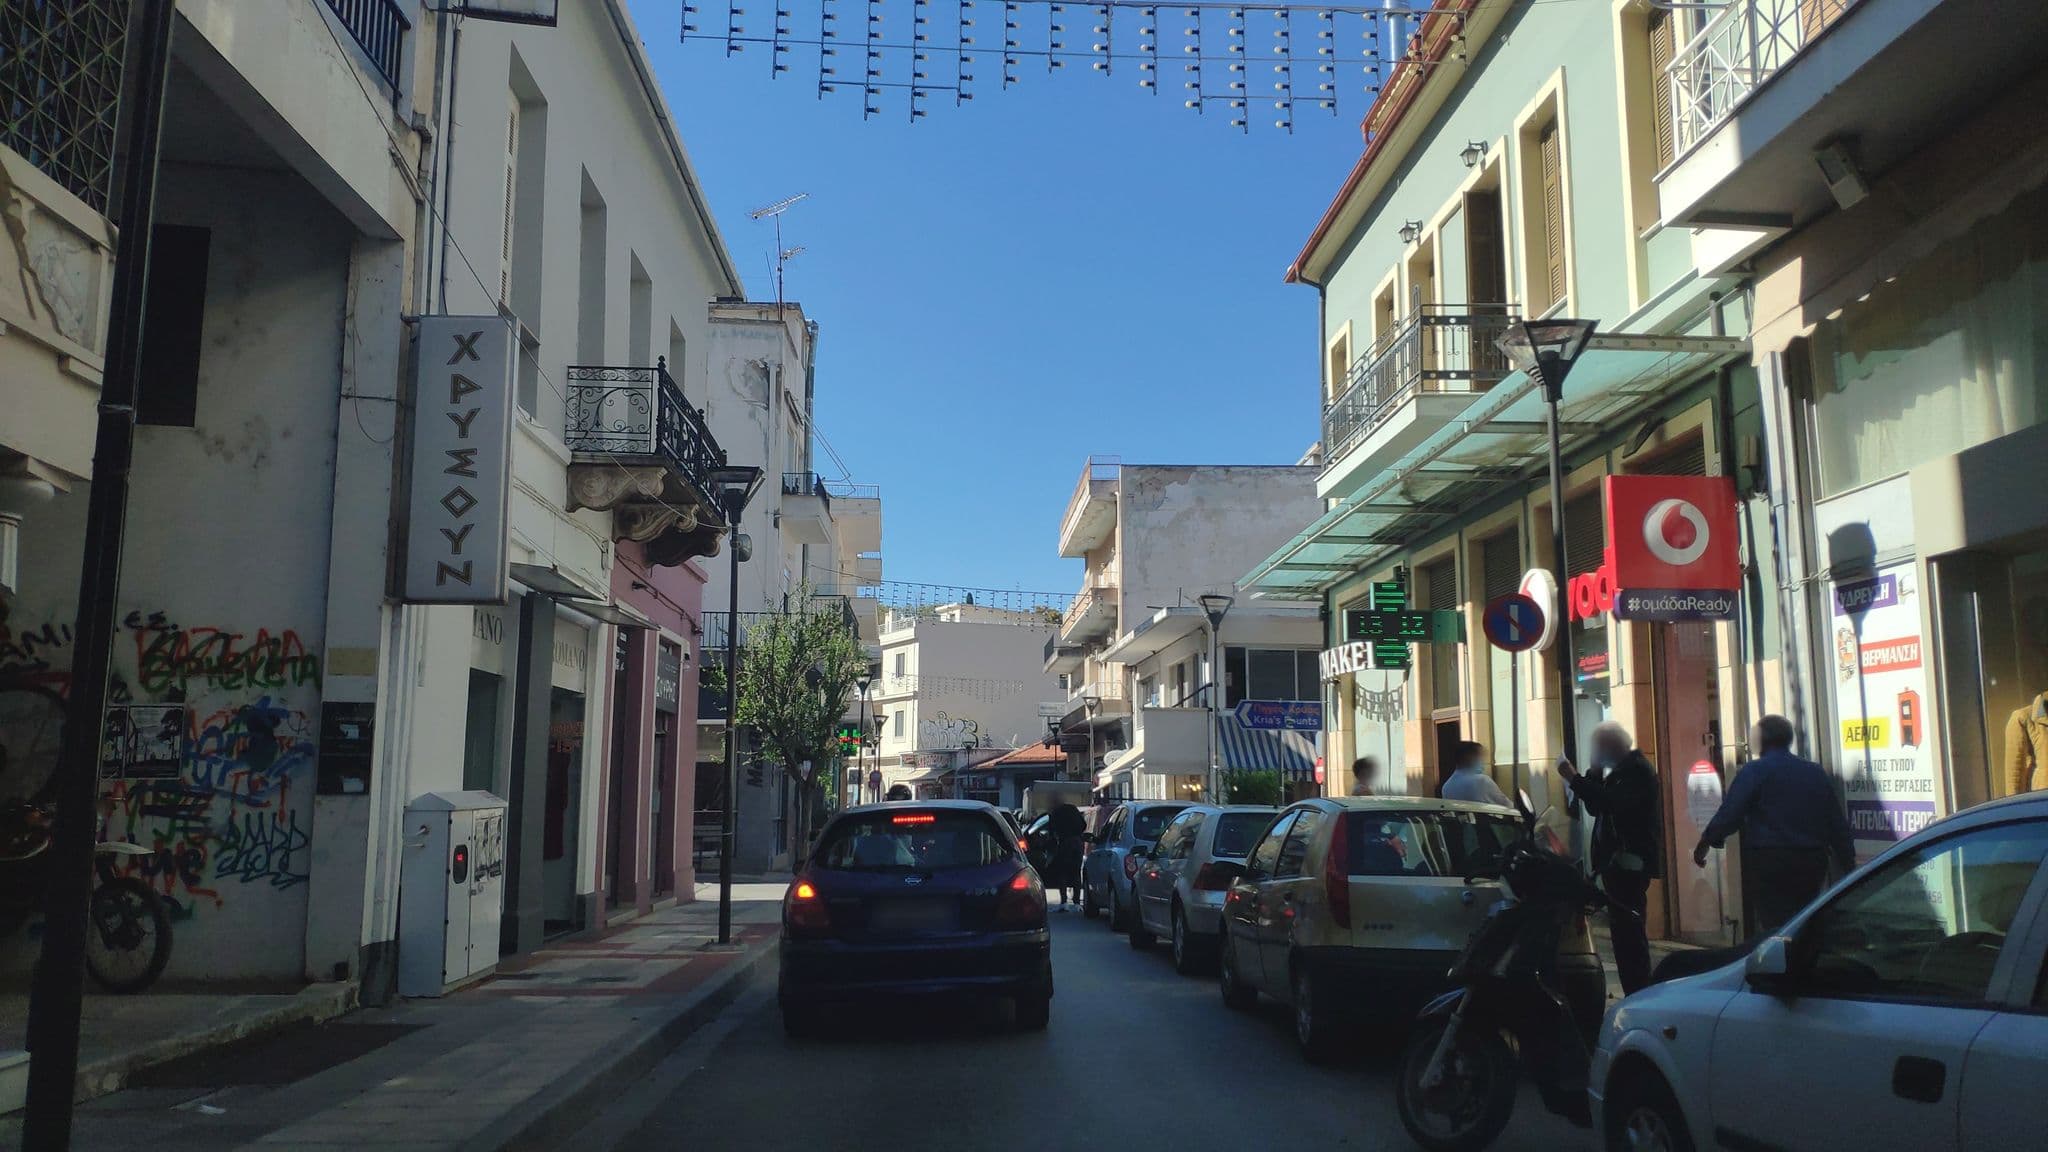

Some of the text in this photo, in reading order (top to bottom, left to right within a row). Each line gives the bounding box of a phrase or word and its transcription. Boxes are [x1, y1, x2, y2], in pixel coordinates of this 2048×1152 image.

[1628, 596, 1732, 614] #ομάδαReady
[1862, 643, 1918, 667] ΘΕΡΜΑΝΣΗ
[1254, 715, 1281, 725] Kria's
[1845, 725, 1880, 742] ΑΕΡΙΟ
[1890, 758, 1915, 772] ΤΥΠΟΥ
[1894, 778, 1933, 793] ΕΡΓΑΣΙΕΣ
